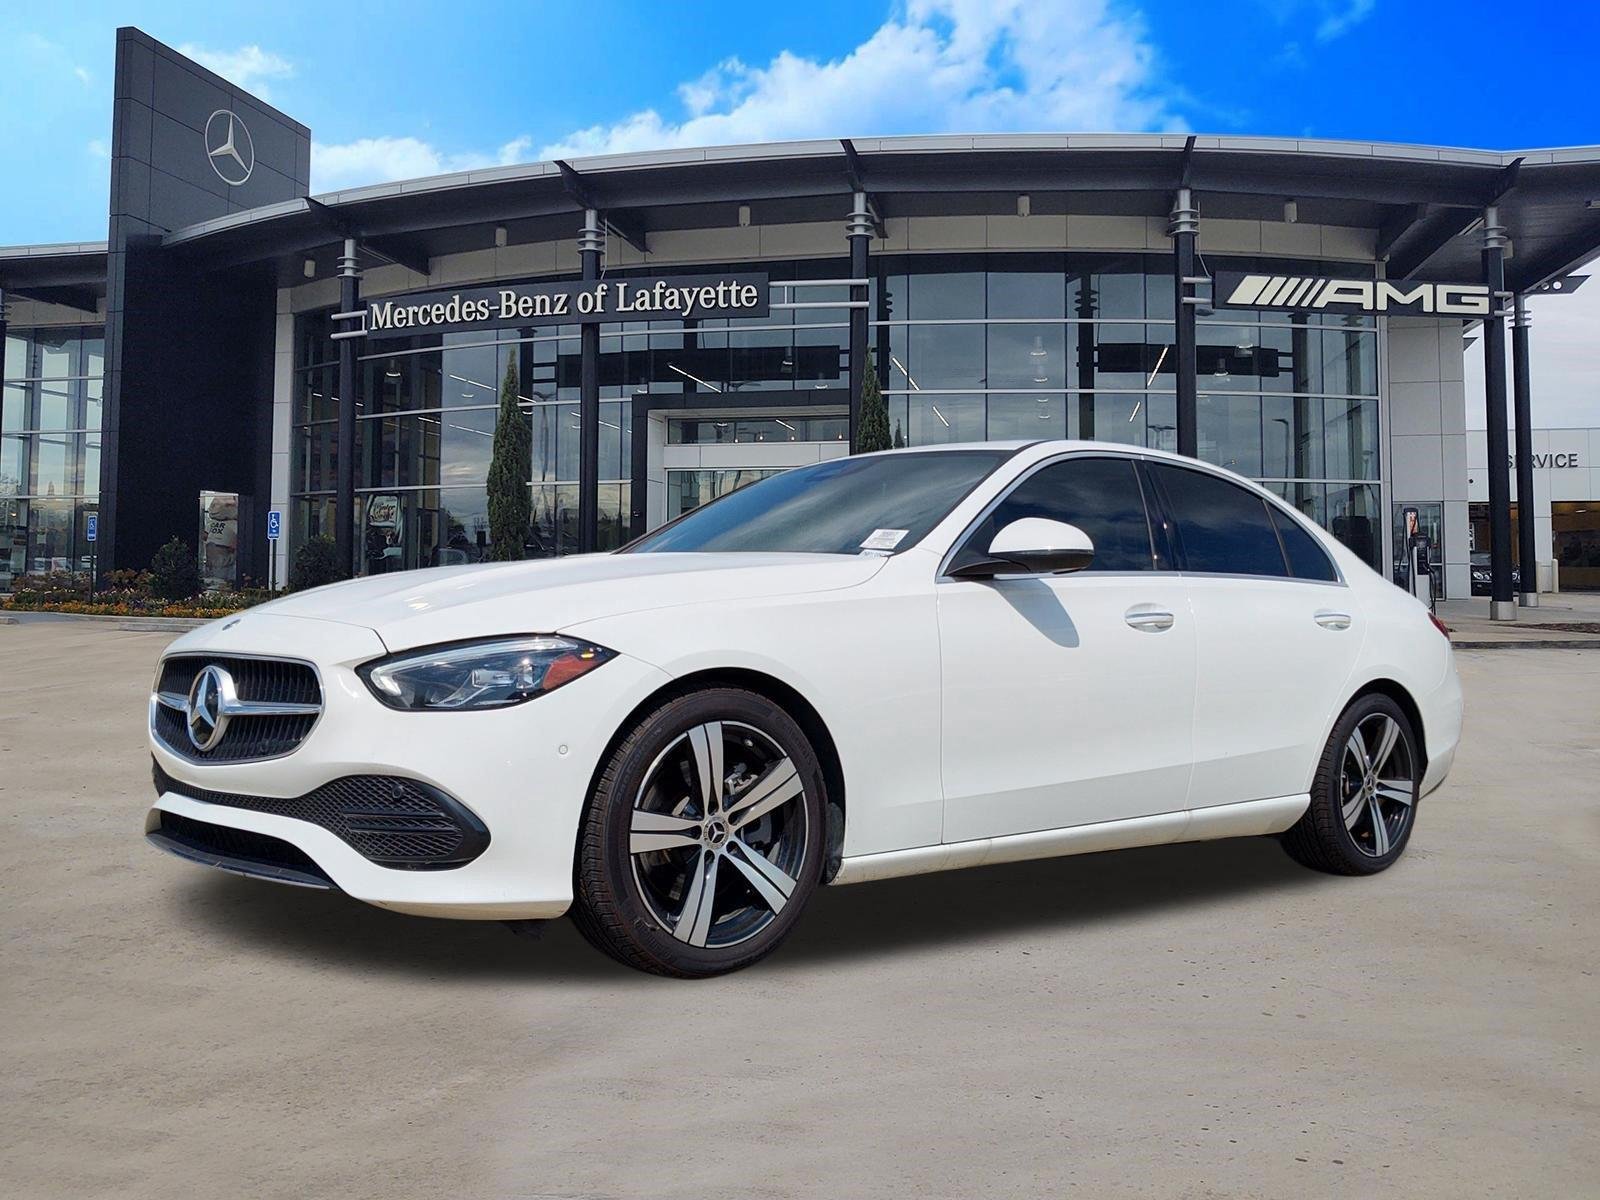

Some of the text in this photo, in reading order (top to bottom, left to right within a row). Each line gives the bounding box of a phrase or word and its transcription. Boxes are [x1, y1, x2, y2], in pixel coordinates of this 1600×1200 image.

[370, 280, 758, 331] Mercedes-Benz of Lafayette
[1312, 279, 1490, 315] AMG
[1507, 453, 1578, 468] SRVICE
[210, 527, 224, 535] OX
